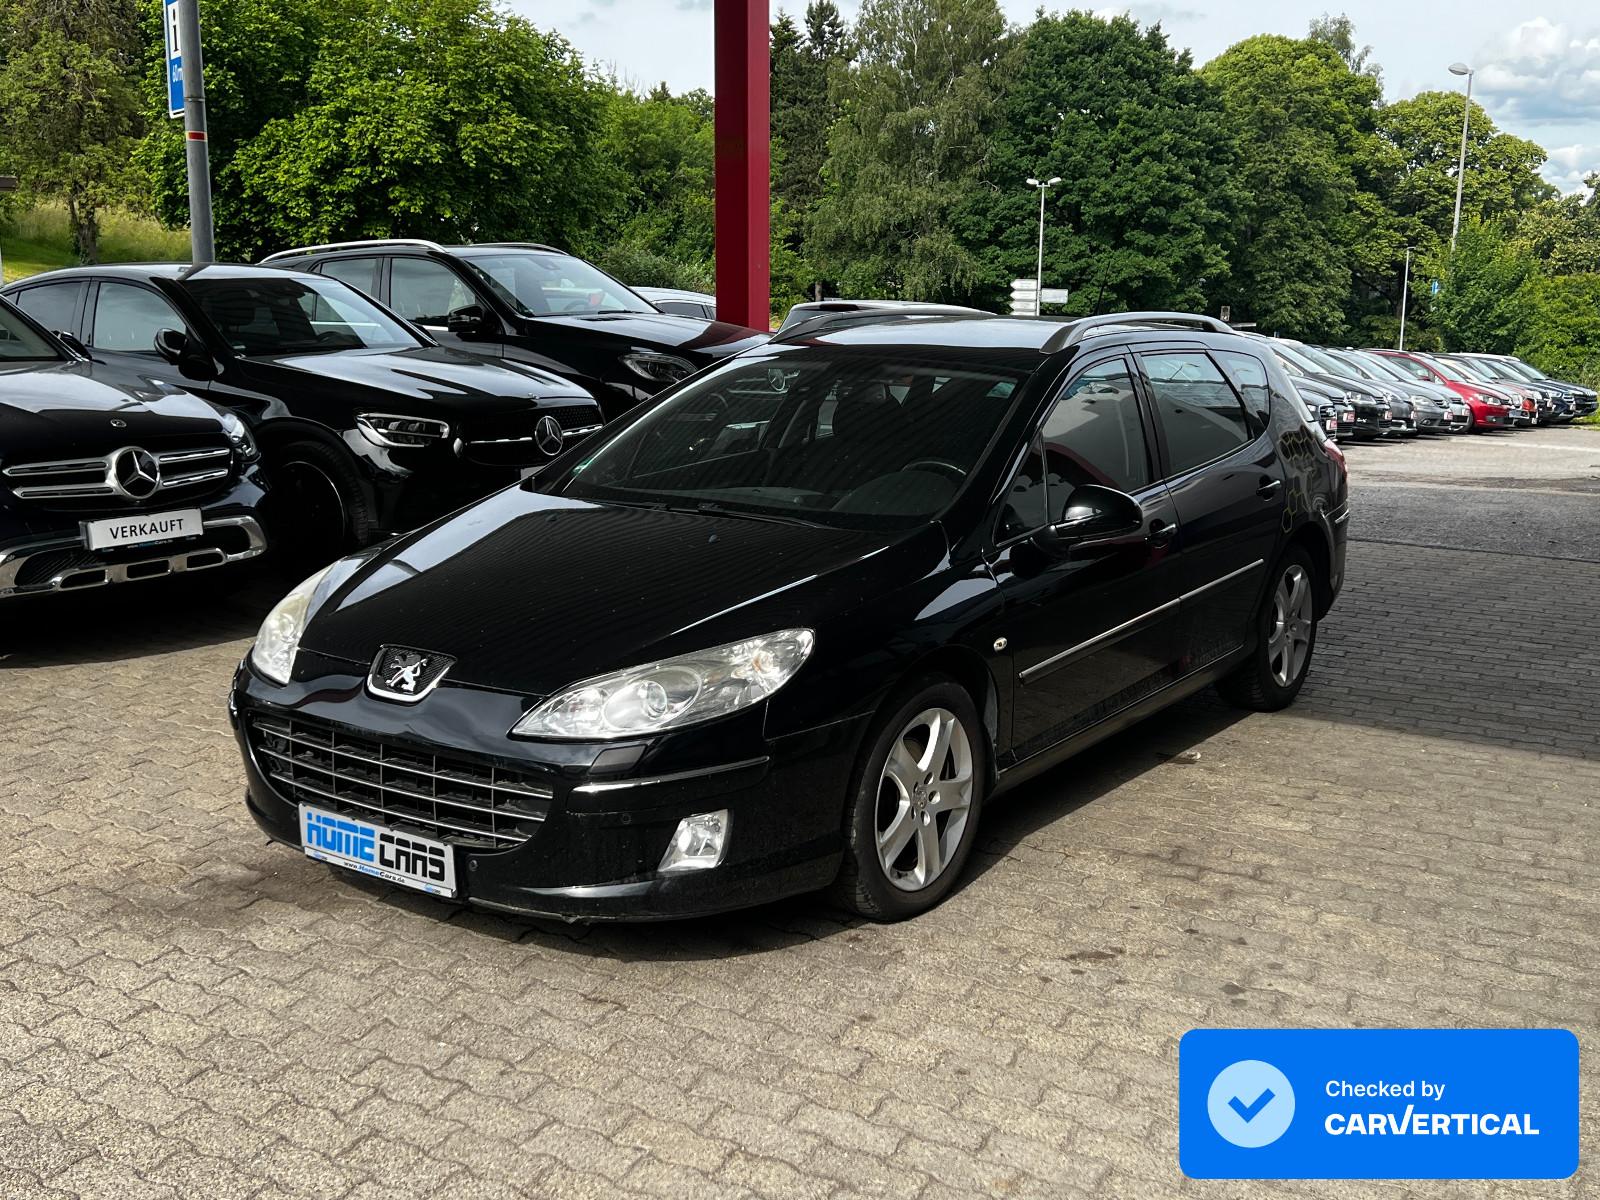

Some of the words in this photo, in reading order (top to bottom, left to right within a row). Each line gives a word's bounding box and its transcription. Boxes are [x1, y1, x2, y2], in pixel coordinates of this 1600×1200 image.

[109, 518, 184, 539] VERKAUFT
[306, 811, 375, 862] HOME
[379, 832, 445, 882] CARS
[344, 861, 406, 884] www.HomeCars.de
